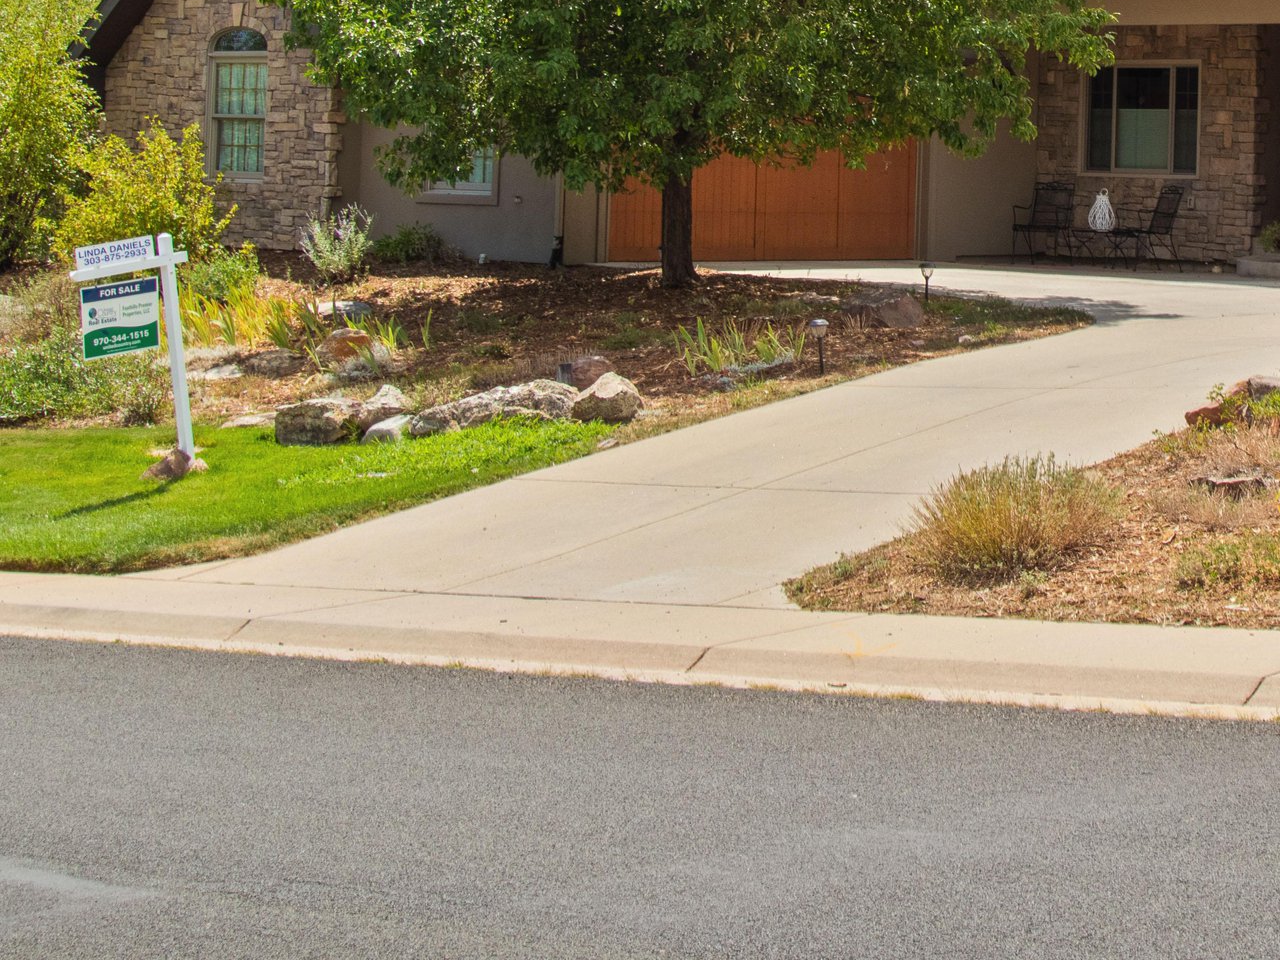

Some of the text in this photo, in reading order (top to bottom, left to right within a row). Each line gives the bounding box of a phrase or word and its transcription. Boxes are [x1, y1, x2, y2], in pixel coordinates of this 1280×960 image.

[78, 239, 151, 259] LINDA DANIELS
[84, 248, 147, 265] 303-875-2933
[99, 284, 140, 298] FOR SALE
[101, 317, 117, 325] Estate
[93, 331, 149, 346] 970-344-1515
